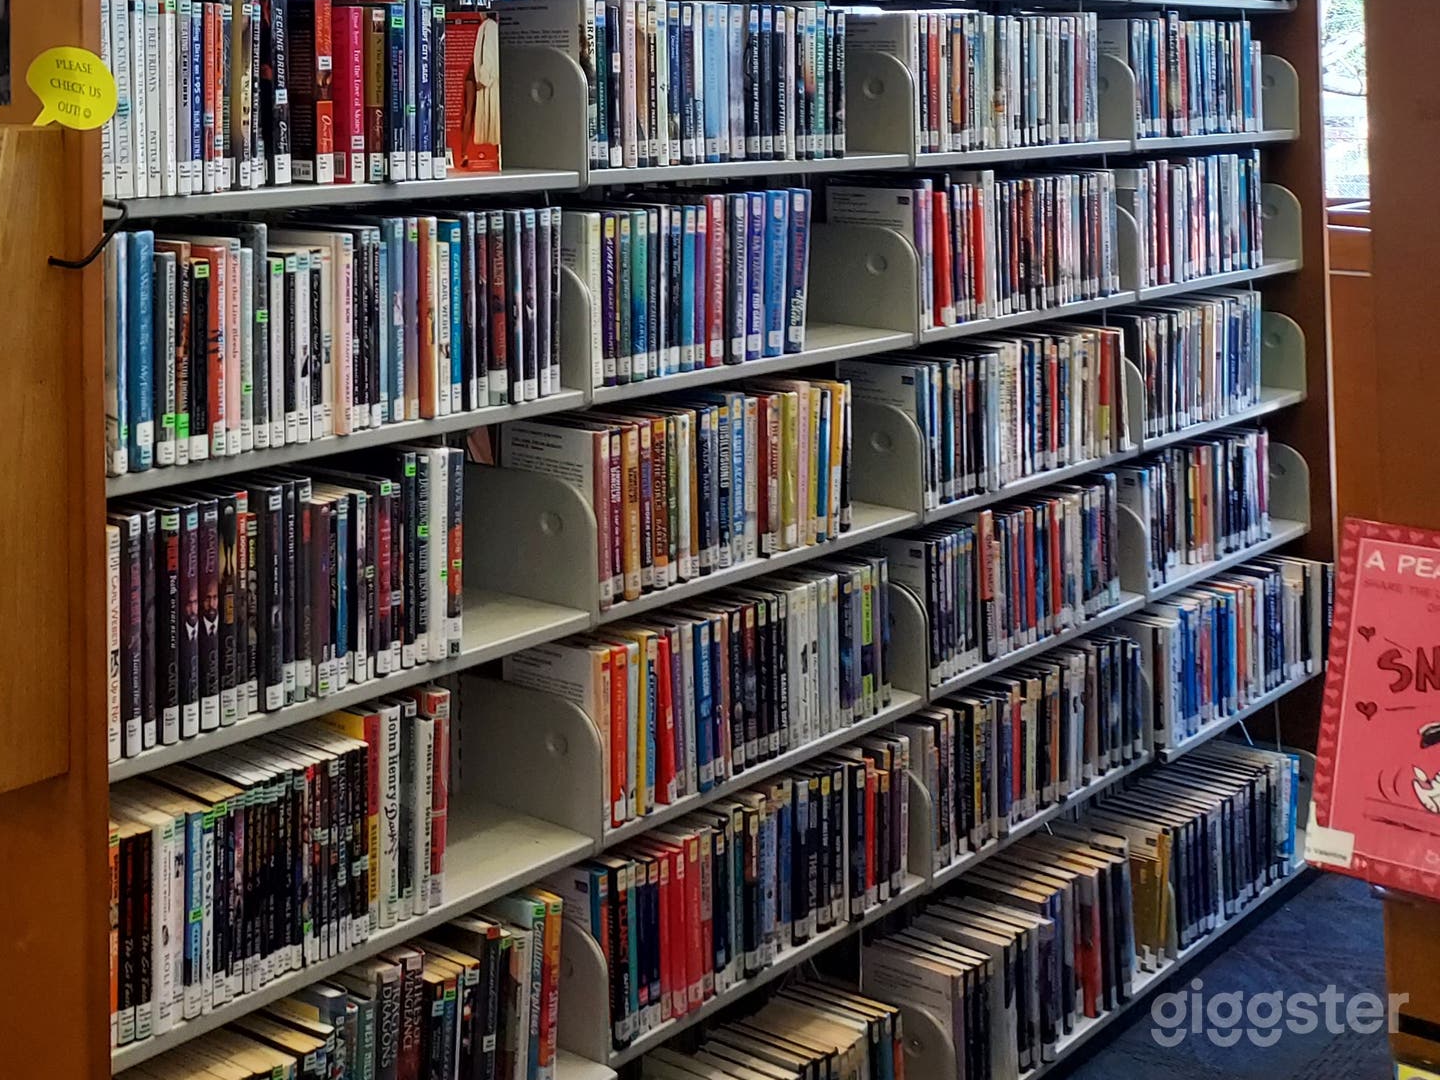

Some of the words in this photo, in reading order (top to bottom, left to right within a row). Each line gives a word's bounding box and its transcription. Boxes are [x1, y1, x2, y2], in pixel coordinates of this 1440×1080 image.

[117, 17, 129, 73] COCKTAIL
[148, 27, 156, 47] FREE
[275, 8, 284, 48] PECKING
[586, 19, 594, 61] BRASS
[55, 58, 92, 74] PLEASE
[277, 50, 285, 88] ORDER
[422, 43, 430, 61] CITY
[49, 78, 85, 95] CHECK
[89, 85, 102, 99] US
[148, 50, 156, 93] FRIDAYS
[353, 65, 361, 80] the
[422, 63, 430, 84] SAGA
[57, 101, 81, 117] OUT!
[1365, 550, 1386, 571] A
[111, 574, 119, 601] CARL
[111, 604, 119, 651] WEBER
[389, 716, 398, 753] John
[388, 756, 398, 800] Henry
[384, 806, 398, 845] Days
[381, 986, 392, 1069] DRAGONS
[403, 970, 413, 1052] VENGEANCE
[363, 1021, 373, 1044] WEST
